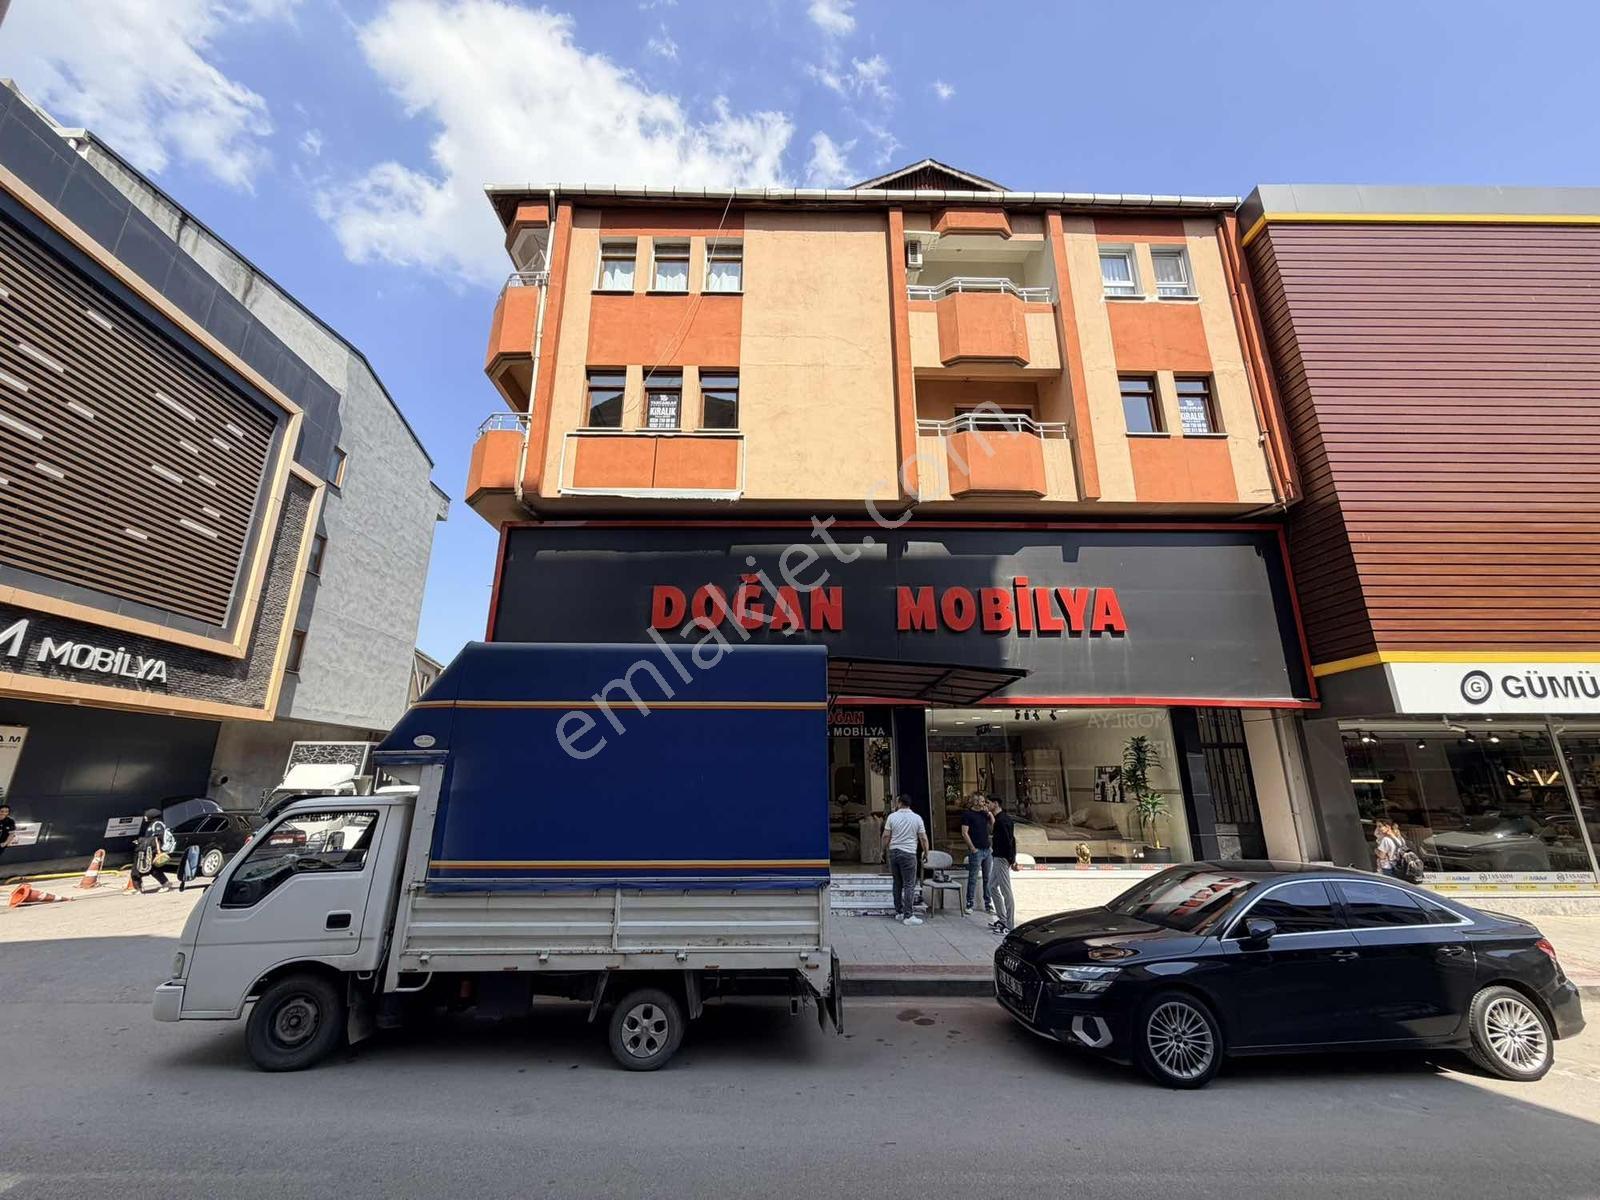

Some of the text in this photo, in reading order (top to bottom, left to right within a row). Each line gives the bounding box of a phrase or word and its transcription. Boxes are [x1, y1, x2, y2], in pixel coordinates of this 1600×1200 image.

[651, 573, 1128, 635] DOĞAN MOBİLYA
[37, 637, 167, 683] MOBİLYA
[1501, 670, 1600, 699] GÜMÜ
[833, 725, 885, 737] MOBİLYA
